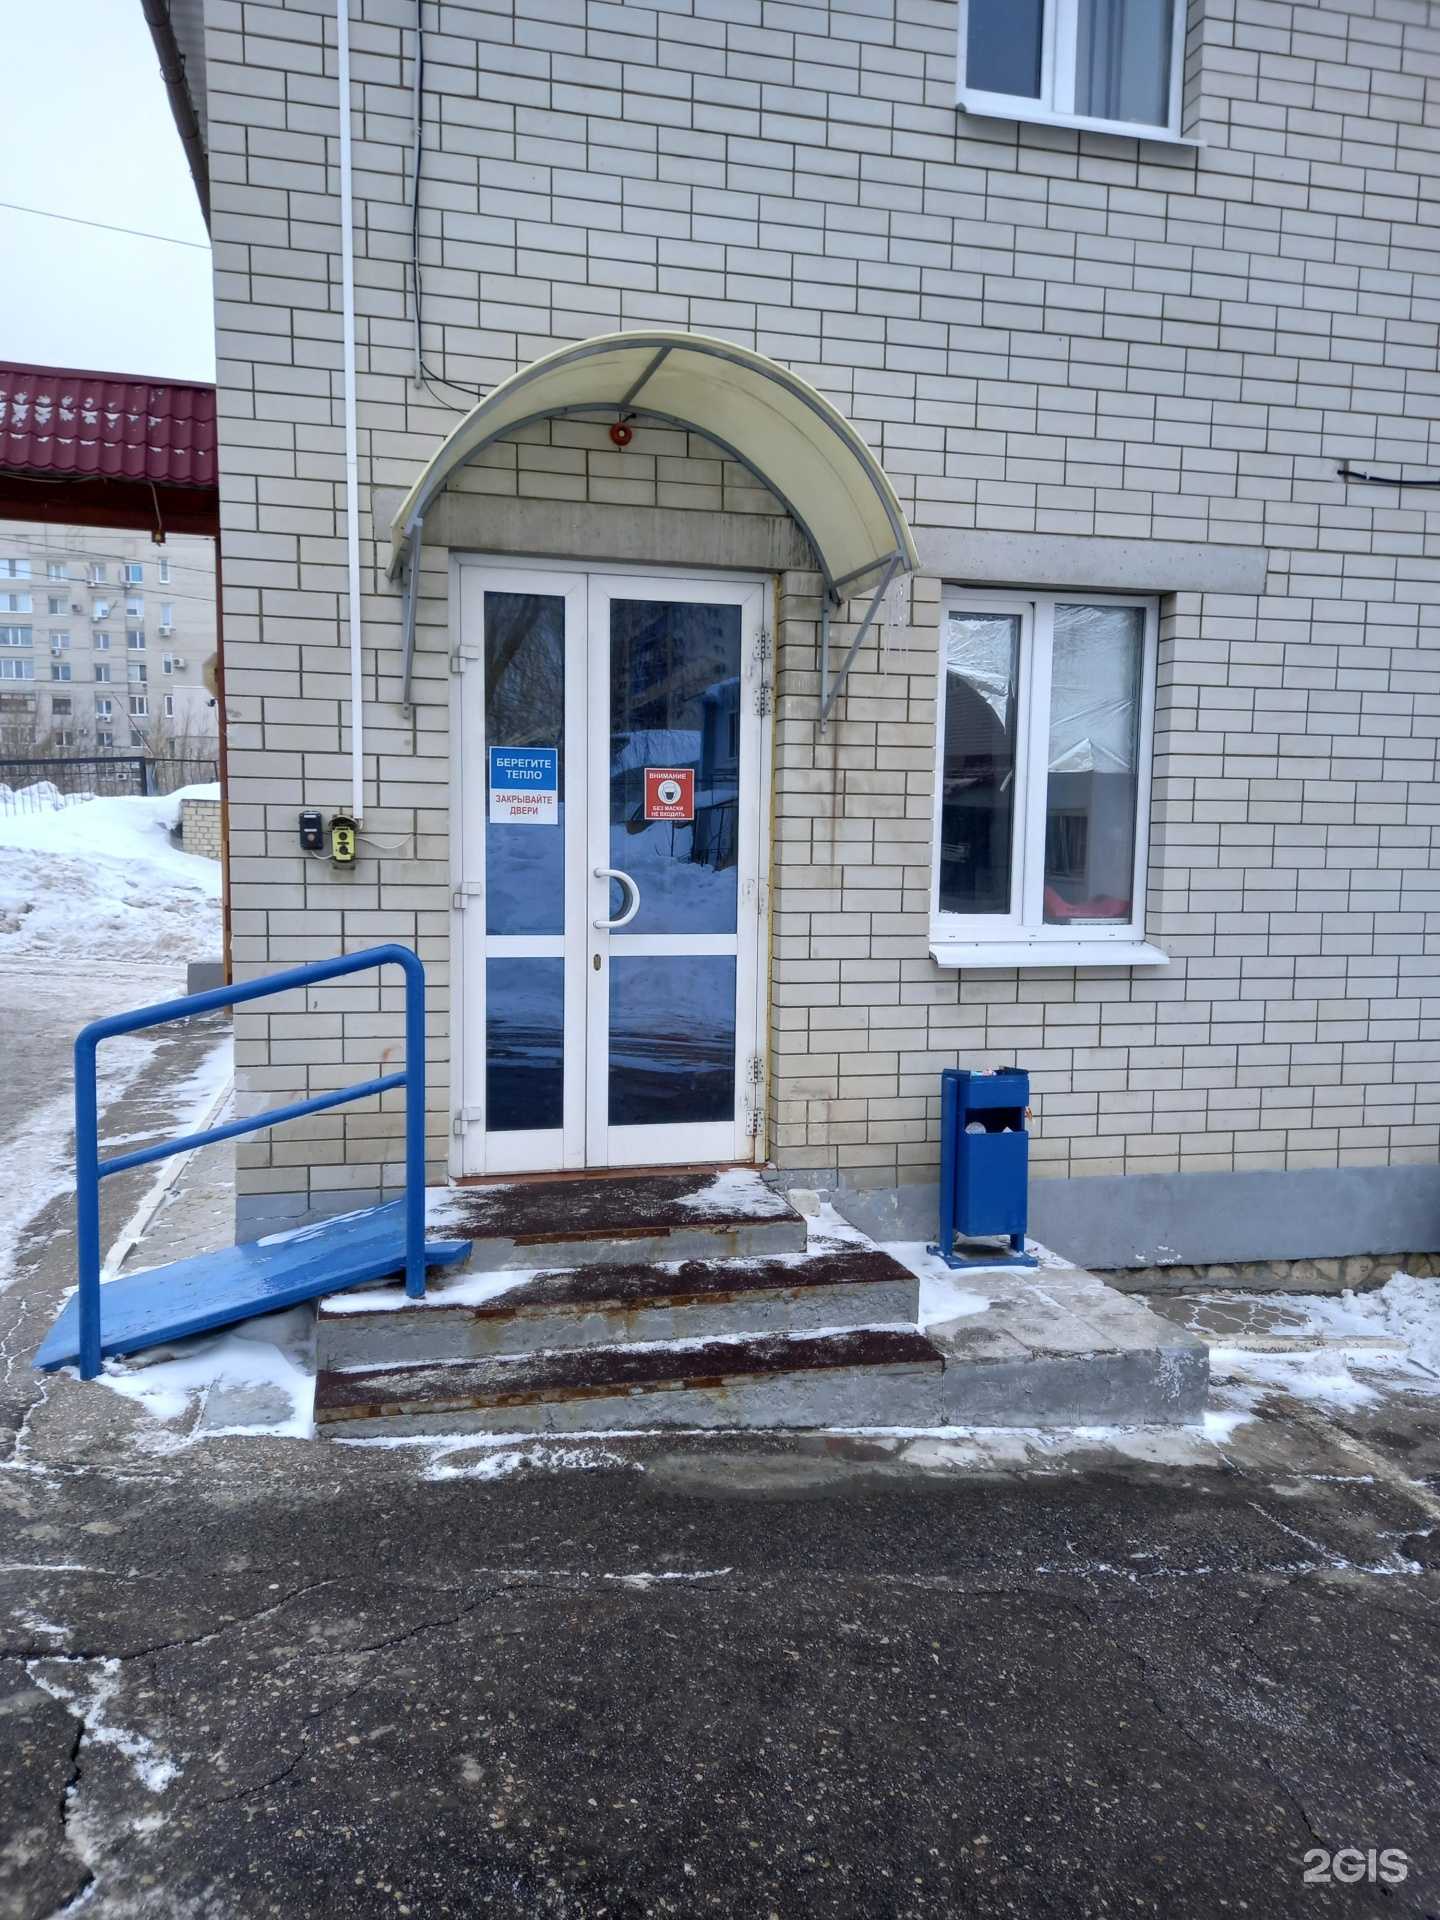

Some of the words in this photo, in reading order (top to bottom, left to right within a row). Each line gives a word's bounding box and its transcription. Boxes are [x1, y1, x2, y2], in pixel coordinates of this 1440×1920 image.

[496, 757, 552, 769] БЕРЕГИТЕ
[505, 769, 543, 780] ТЕПЛО
[649, 772, 687, 780] ВНИМАНИЕ
[495, 794, 553, 805] ЗАКРЫВАЙТЕ
[509, 806, 539, 817] ДВЕРИ
